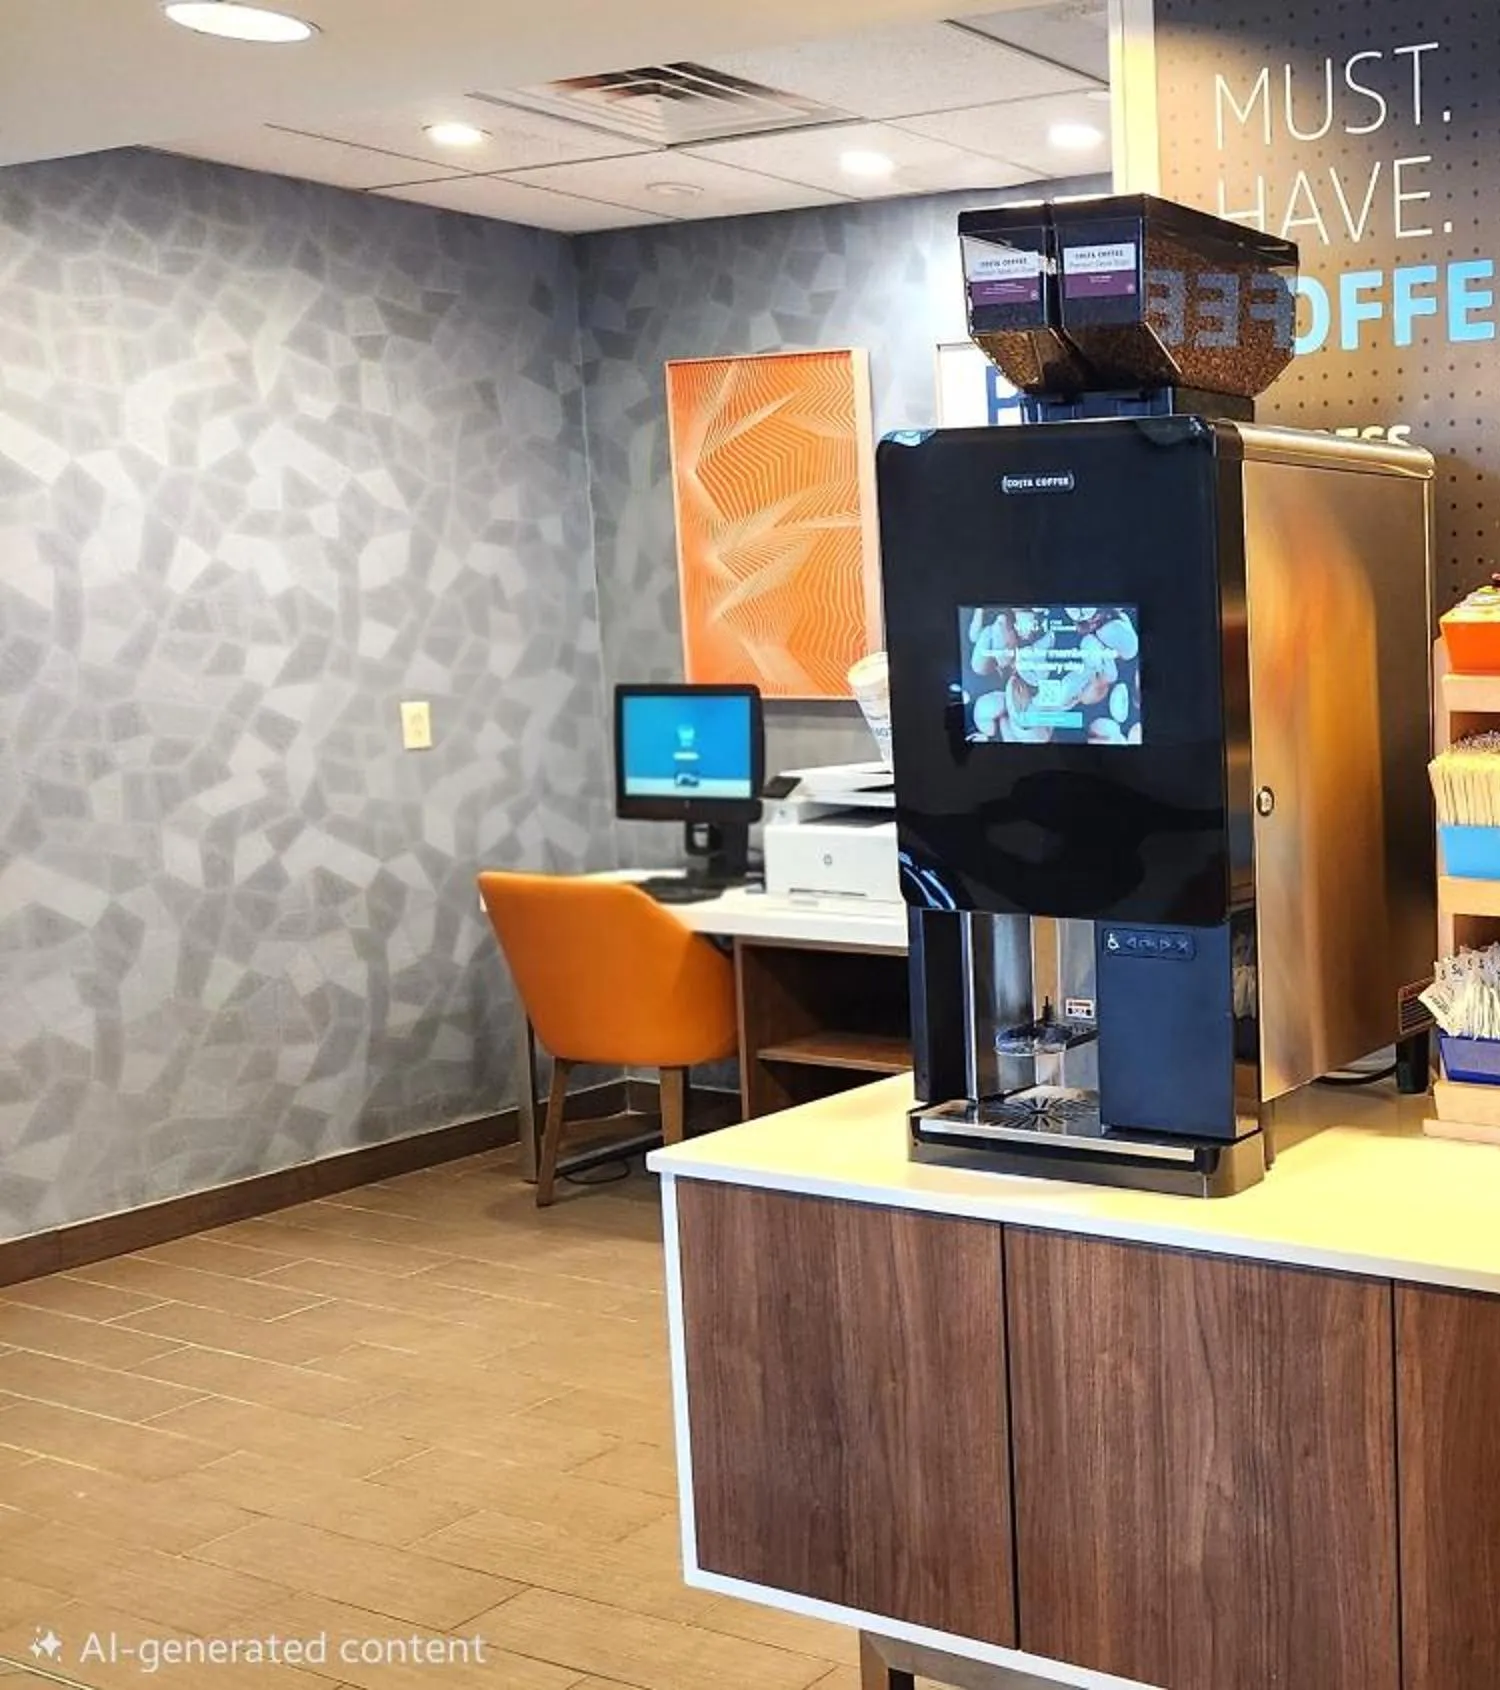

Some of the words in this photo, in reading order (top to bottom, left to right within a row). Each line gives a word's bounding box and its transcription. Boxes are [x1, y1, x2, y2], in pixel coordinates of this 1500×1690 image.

[1214, 42, 1452, 150] MUST.
[1217, 155, 1453, 246] HAVE.
[1007, 479, 1033, 489] COSTA
[1035, 476, 1069, 488] COFFEE
